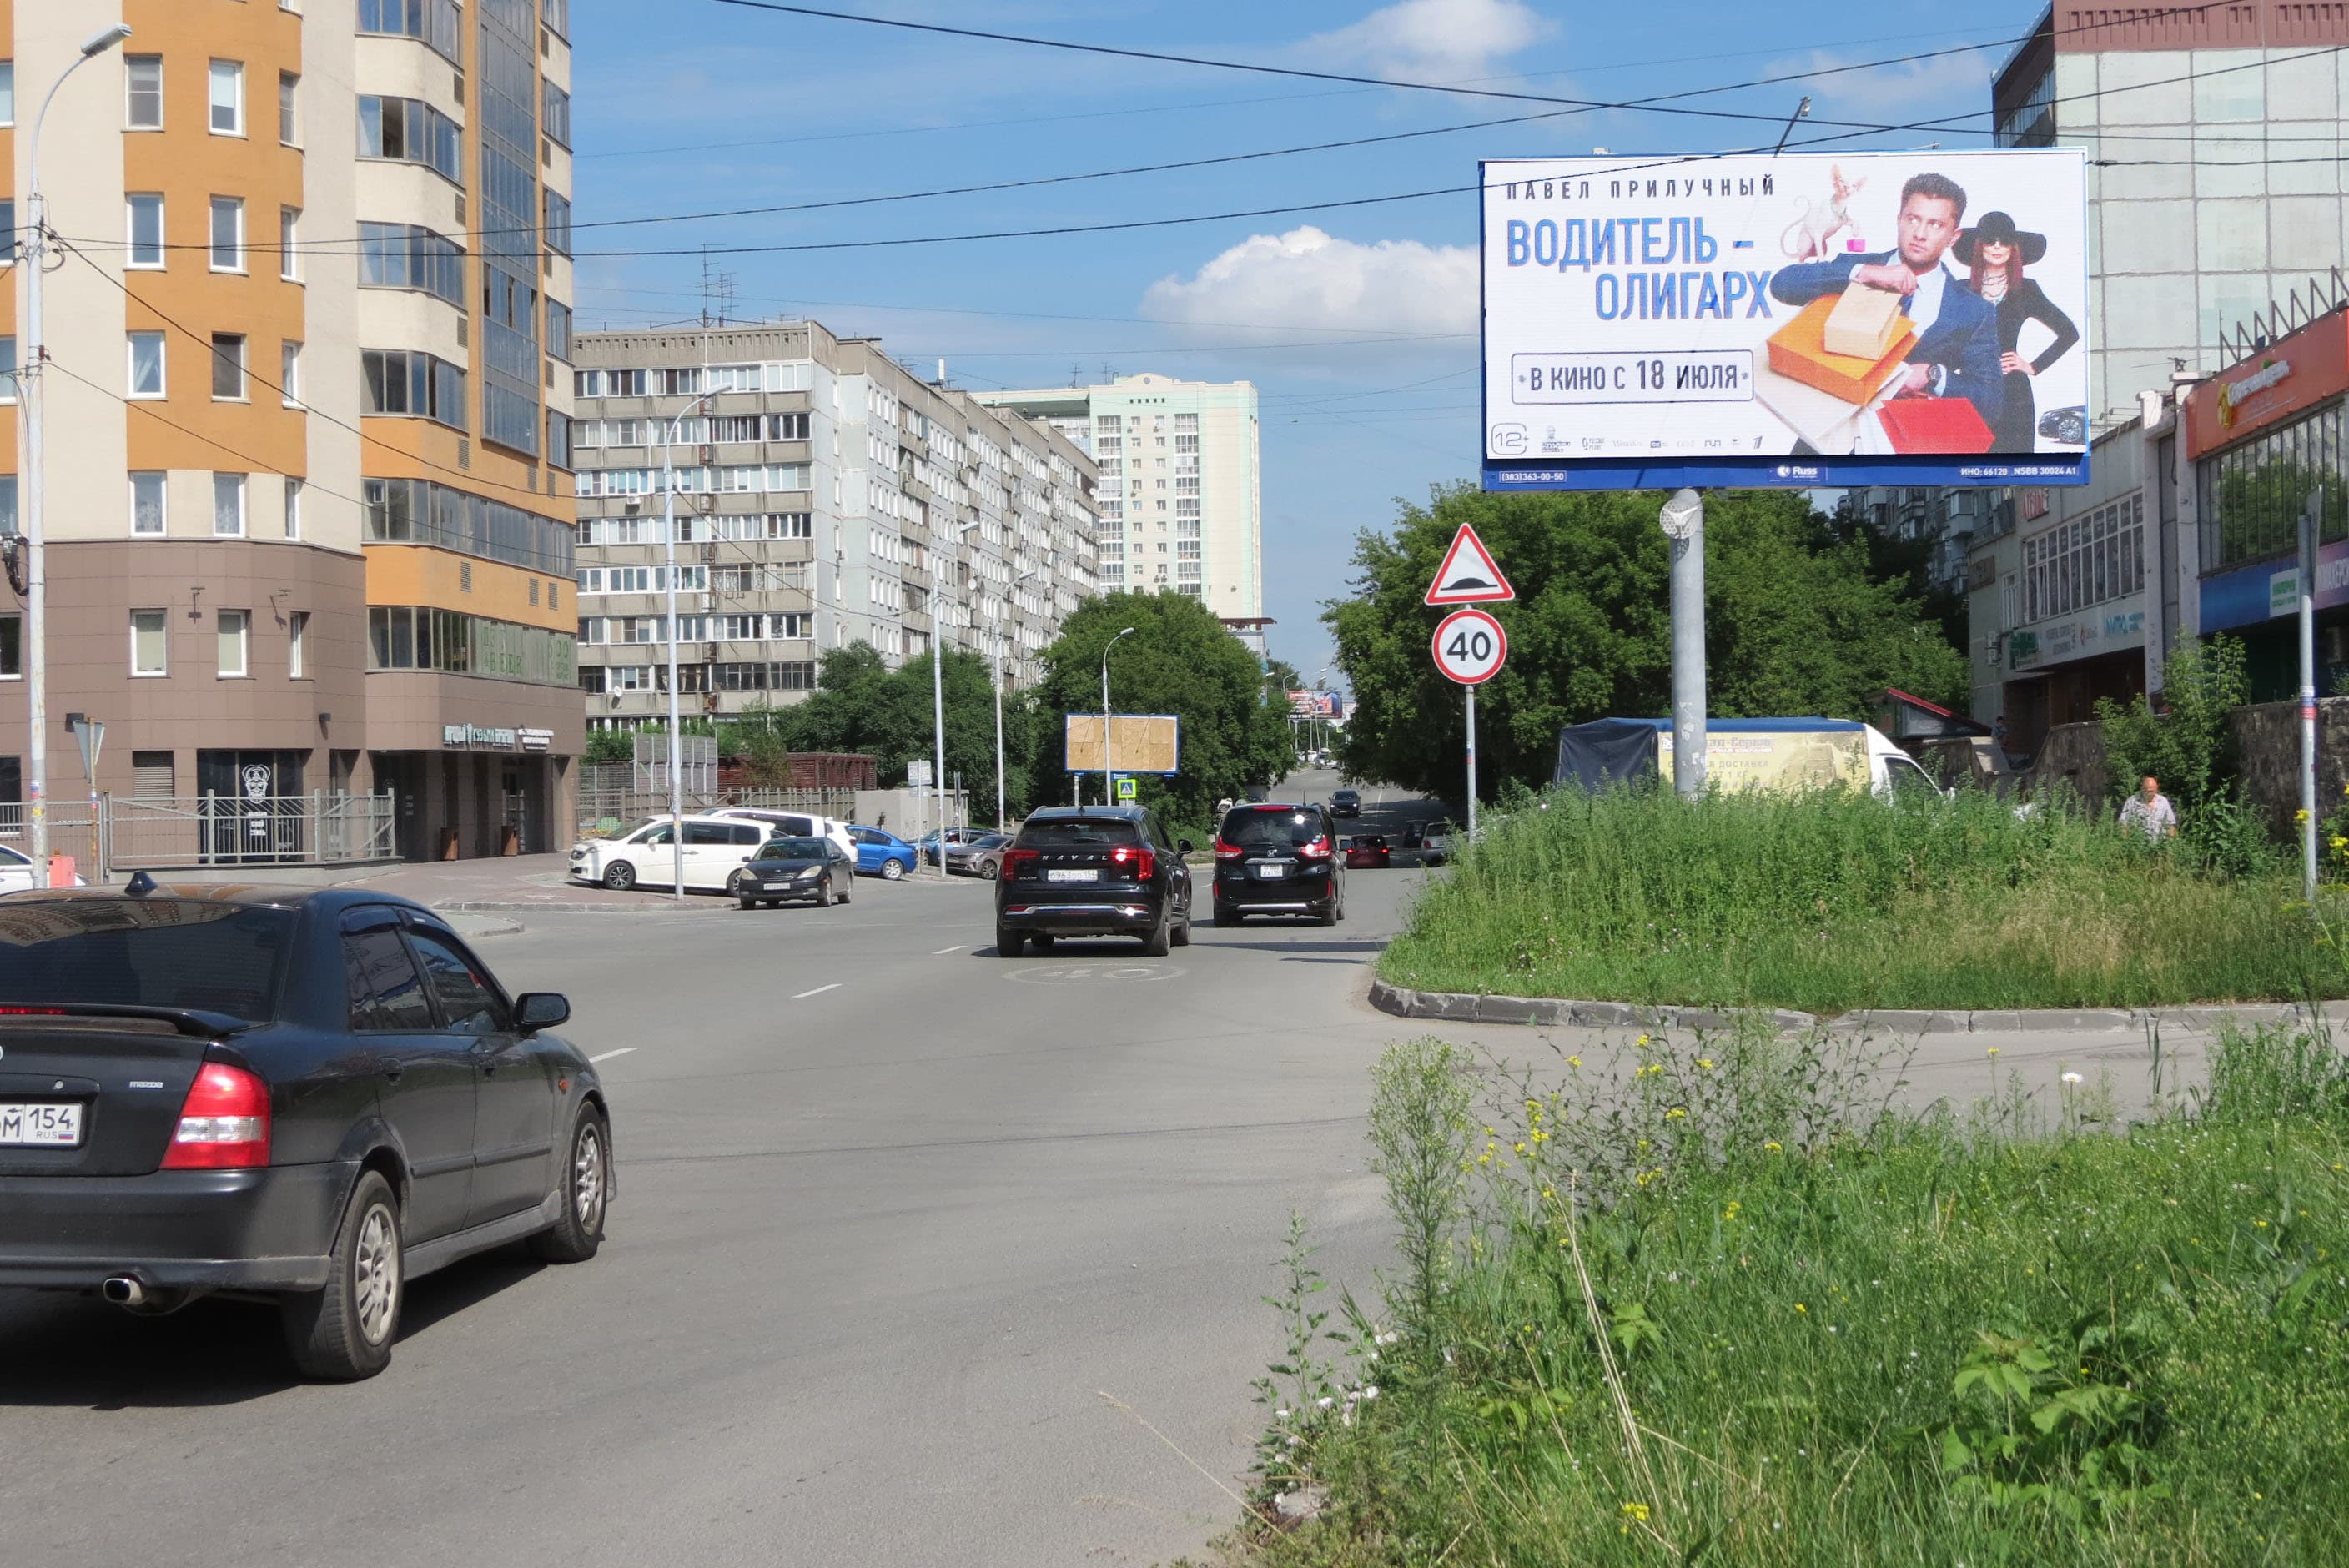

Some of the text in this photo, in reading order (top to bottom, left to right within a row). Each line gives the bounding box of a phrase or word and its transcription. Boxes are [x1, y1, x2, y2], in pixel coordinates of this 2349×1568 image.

[1506, 173, 1774, 200] ПАВЕЛ ПРИЛУЧНЫЙ
[1506, 216, 1719, 274] ВОДИТЕЛЬ
[1594, 270, 1773, 321] ОЛИГАРХ
[1530, 360, 1738, 391] В КИНО С 18 ИЮЛЯ
[1495, 431, 1529, 448] 12+
[1446, 631, 1491, 661] 40
[1719, 760, 1769, 769] ДОСТАВКА
[129, 1080, 164, 1089] mazda
[0, 1107, 71, 1138] М 154
[36, 1130, 58, 1140] RUS
